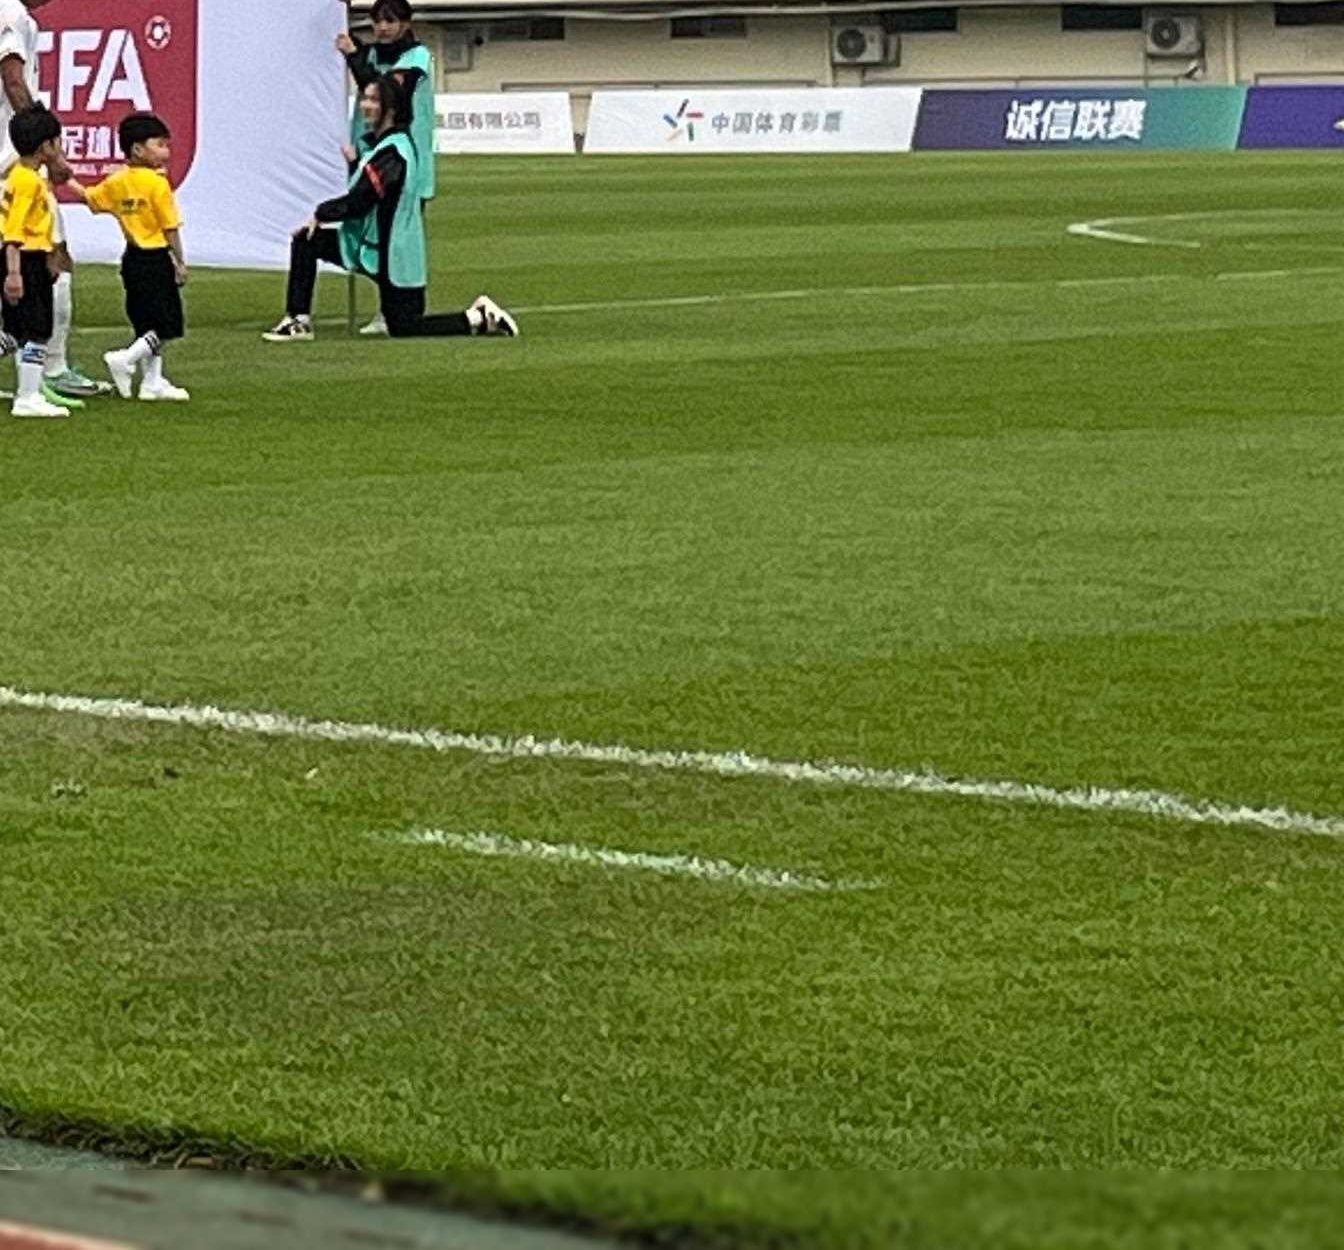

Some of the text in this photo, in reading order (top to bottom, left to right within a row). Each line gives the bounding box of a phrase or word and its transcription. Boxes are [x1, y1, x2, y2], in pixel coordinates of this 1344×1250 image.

[711, 111, 843, 134] 中国体育彩票
[1005, 100, 1147, 141] 诚信联赛
[62, 125, 125, 160] 足球
